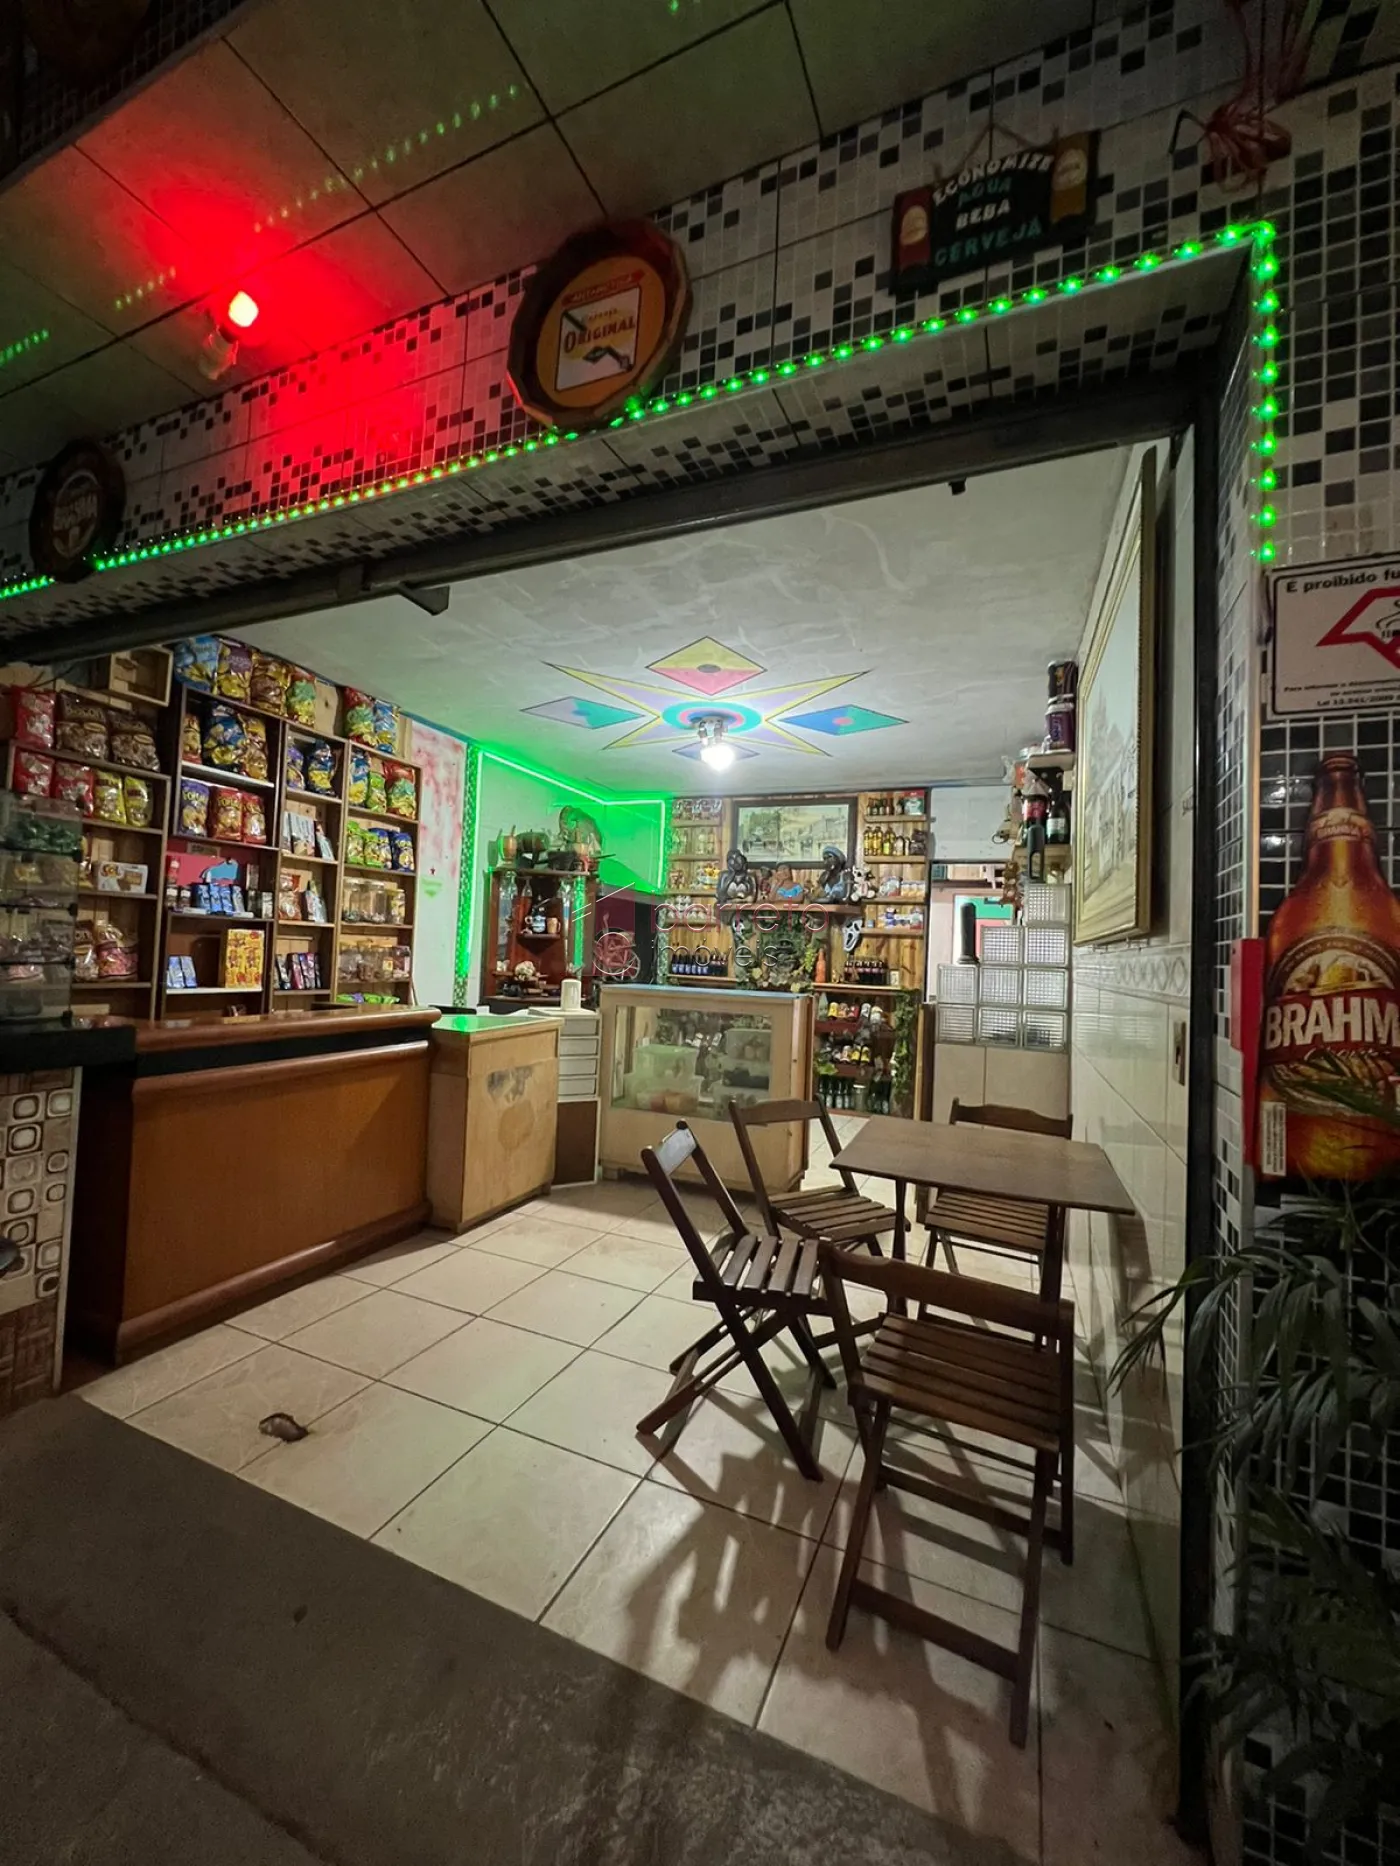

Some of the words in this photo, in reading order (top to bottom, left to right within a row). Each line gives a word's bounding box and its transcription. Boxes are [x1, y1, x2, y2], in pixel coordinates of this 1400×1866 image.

[932, 152, 1054, 205] ECONOMIZE
[956, 198, 1011, 231] BEBA
[934, 215, 1042, 267] CERVEJA
[1303, 572, 1377, 593] proibido
[1265, 996, 1400, 1050] BRAHM
